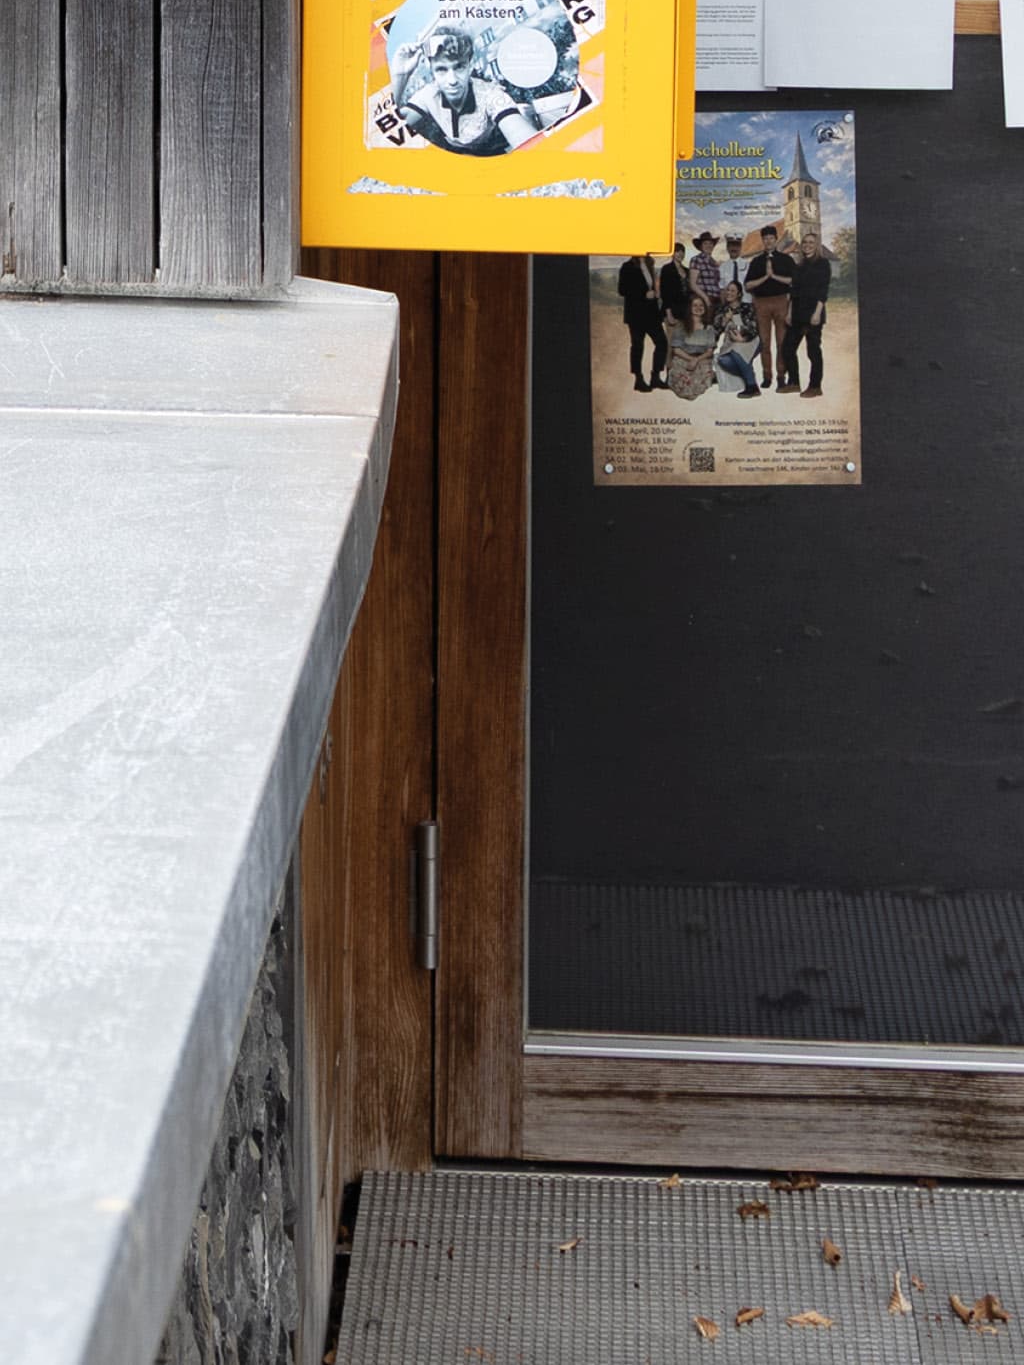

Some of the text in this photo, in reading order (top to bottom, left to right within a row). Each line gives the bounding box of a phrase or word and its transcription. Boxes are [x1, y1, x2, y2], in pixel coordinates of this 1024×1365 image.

[439, 6, 525, 20] am Kasten?
[695, 140, 766, 158] schollene
